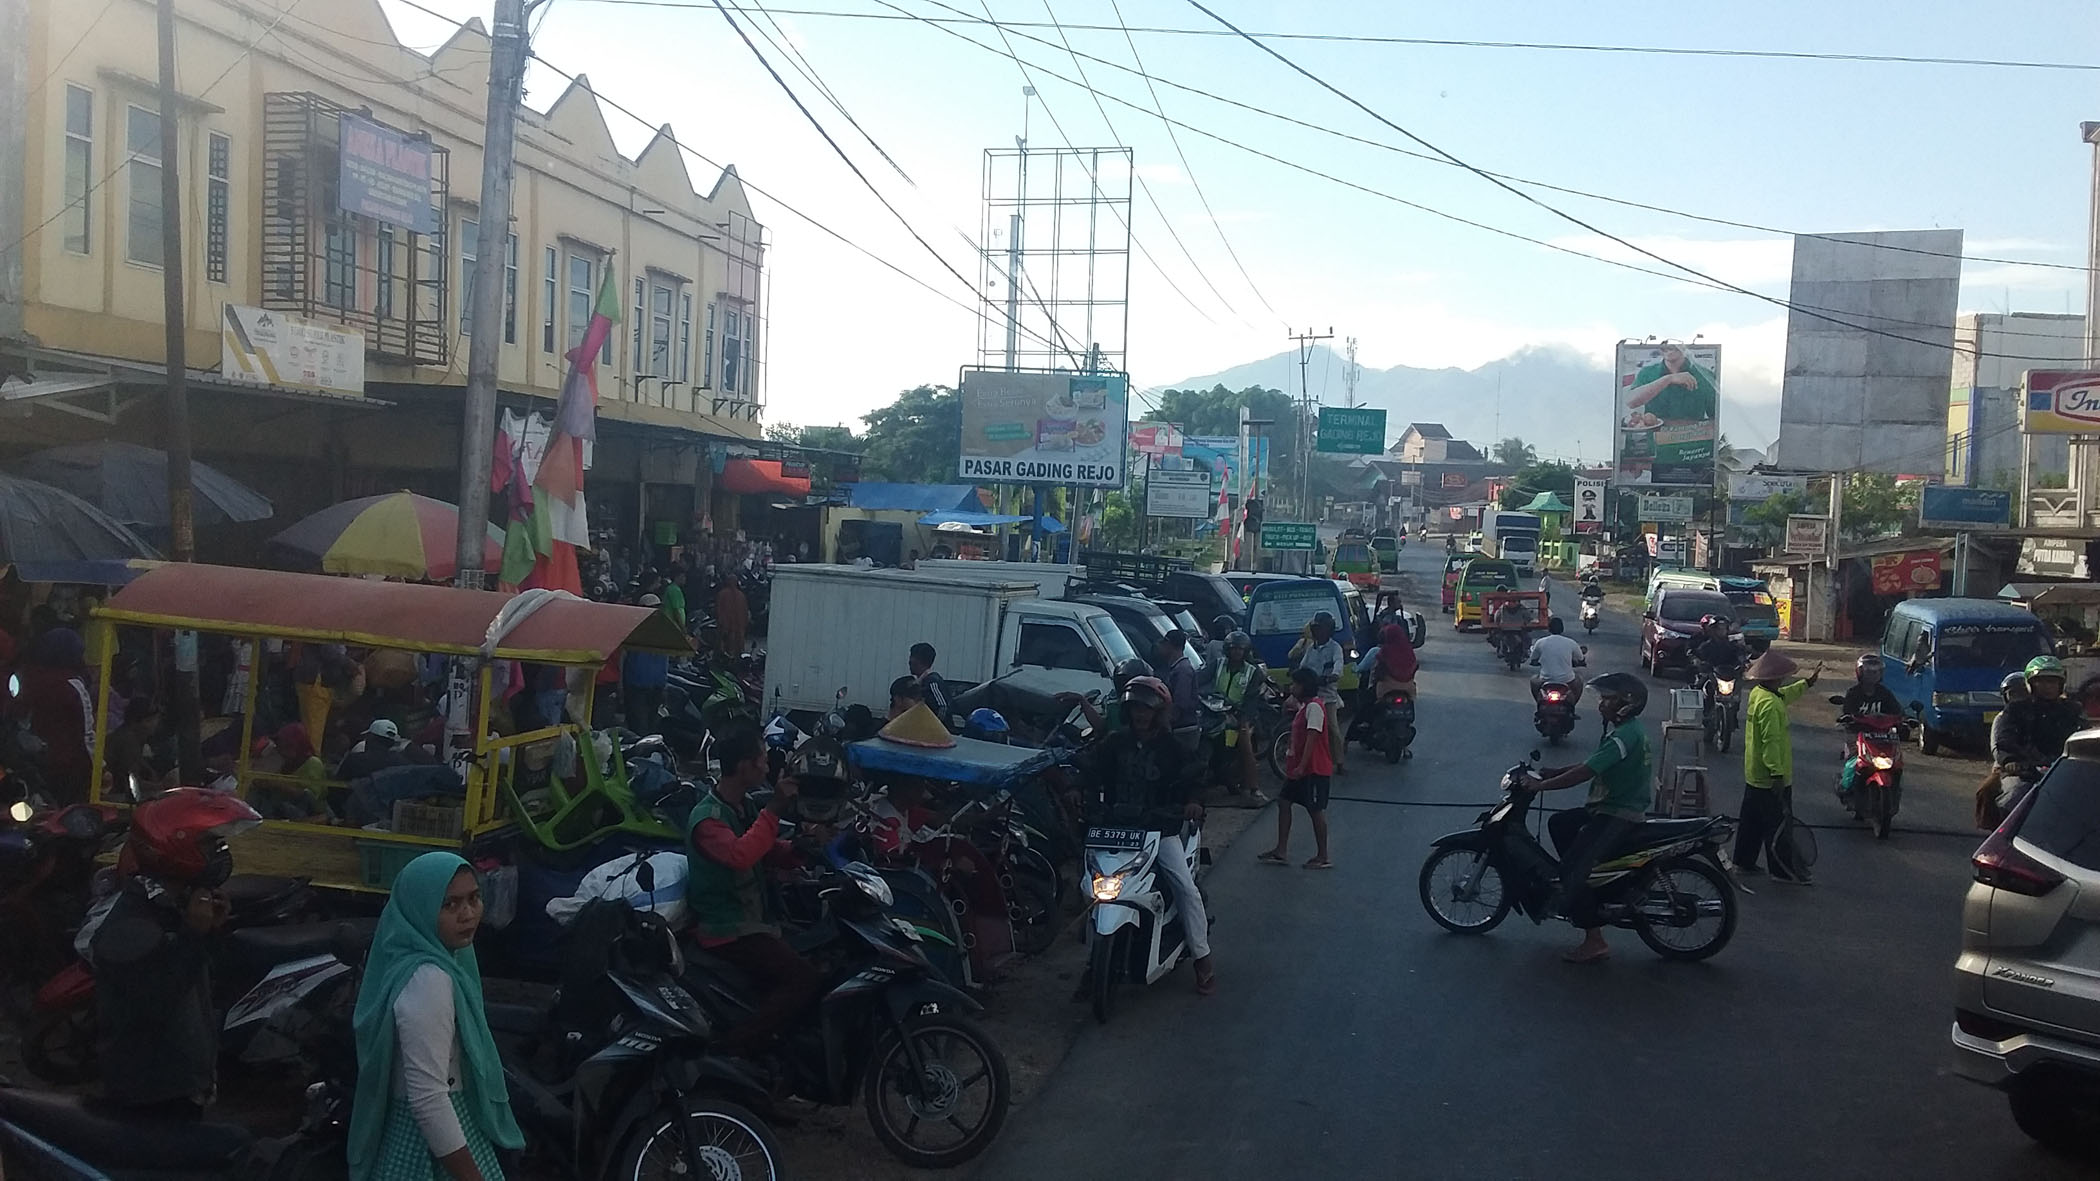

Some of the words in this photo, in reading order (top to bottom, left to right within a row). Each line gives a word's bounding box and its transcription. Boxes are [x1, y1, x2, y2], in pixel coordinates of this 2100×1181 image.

[1327, 414, 1377, 426] TERMINAL
[965, 460, 1012, 476] PASAR
[1016, 461, 1073, 479] GADING
[1077, 464, 1115, 481] REJO
[1090, 829, 1102, 838] BE
[1104, 830, 1126, 839] 5379
[871, 965, 896, 976] HONDA
[856, 971, 892, 984] 110
[1992, 966, 2055, 988] XPANDER
[635, 1031, 663, 1043] HONDA
[617, 1037, 658, 1051] 110
